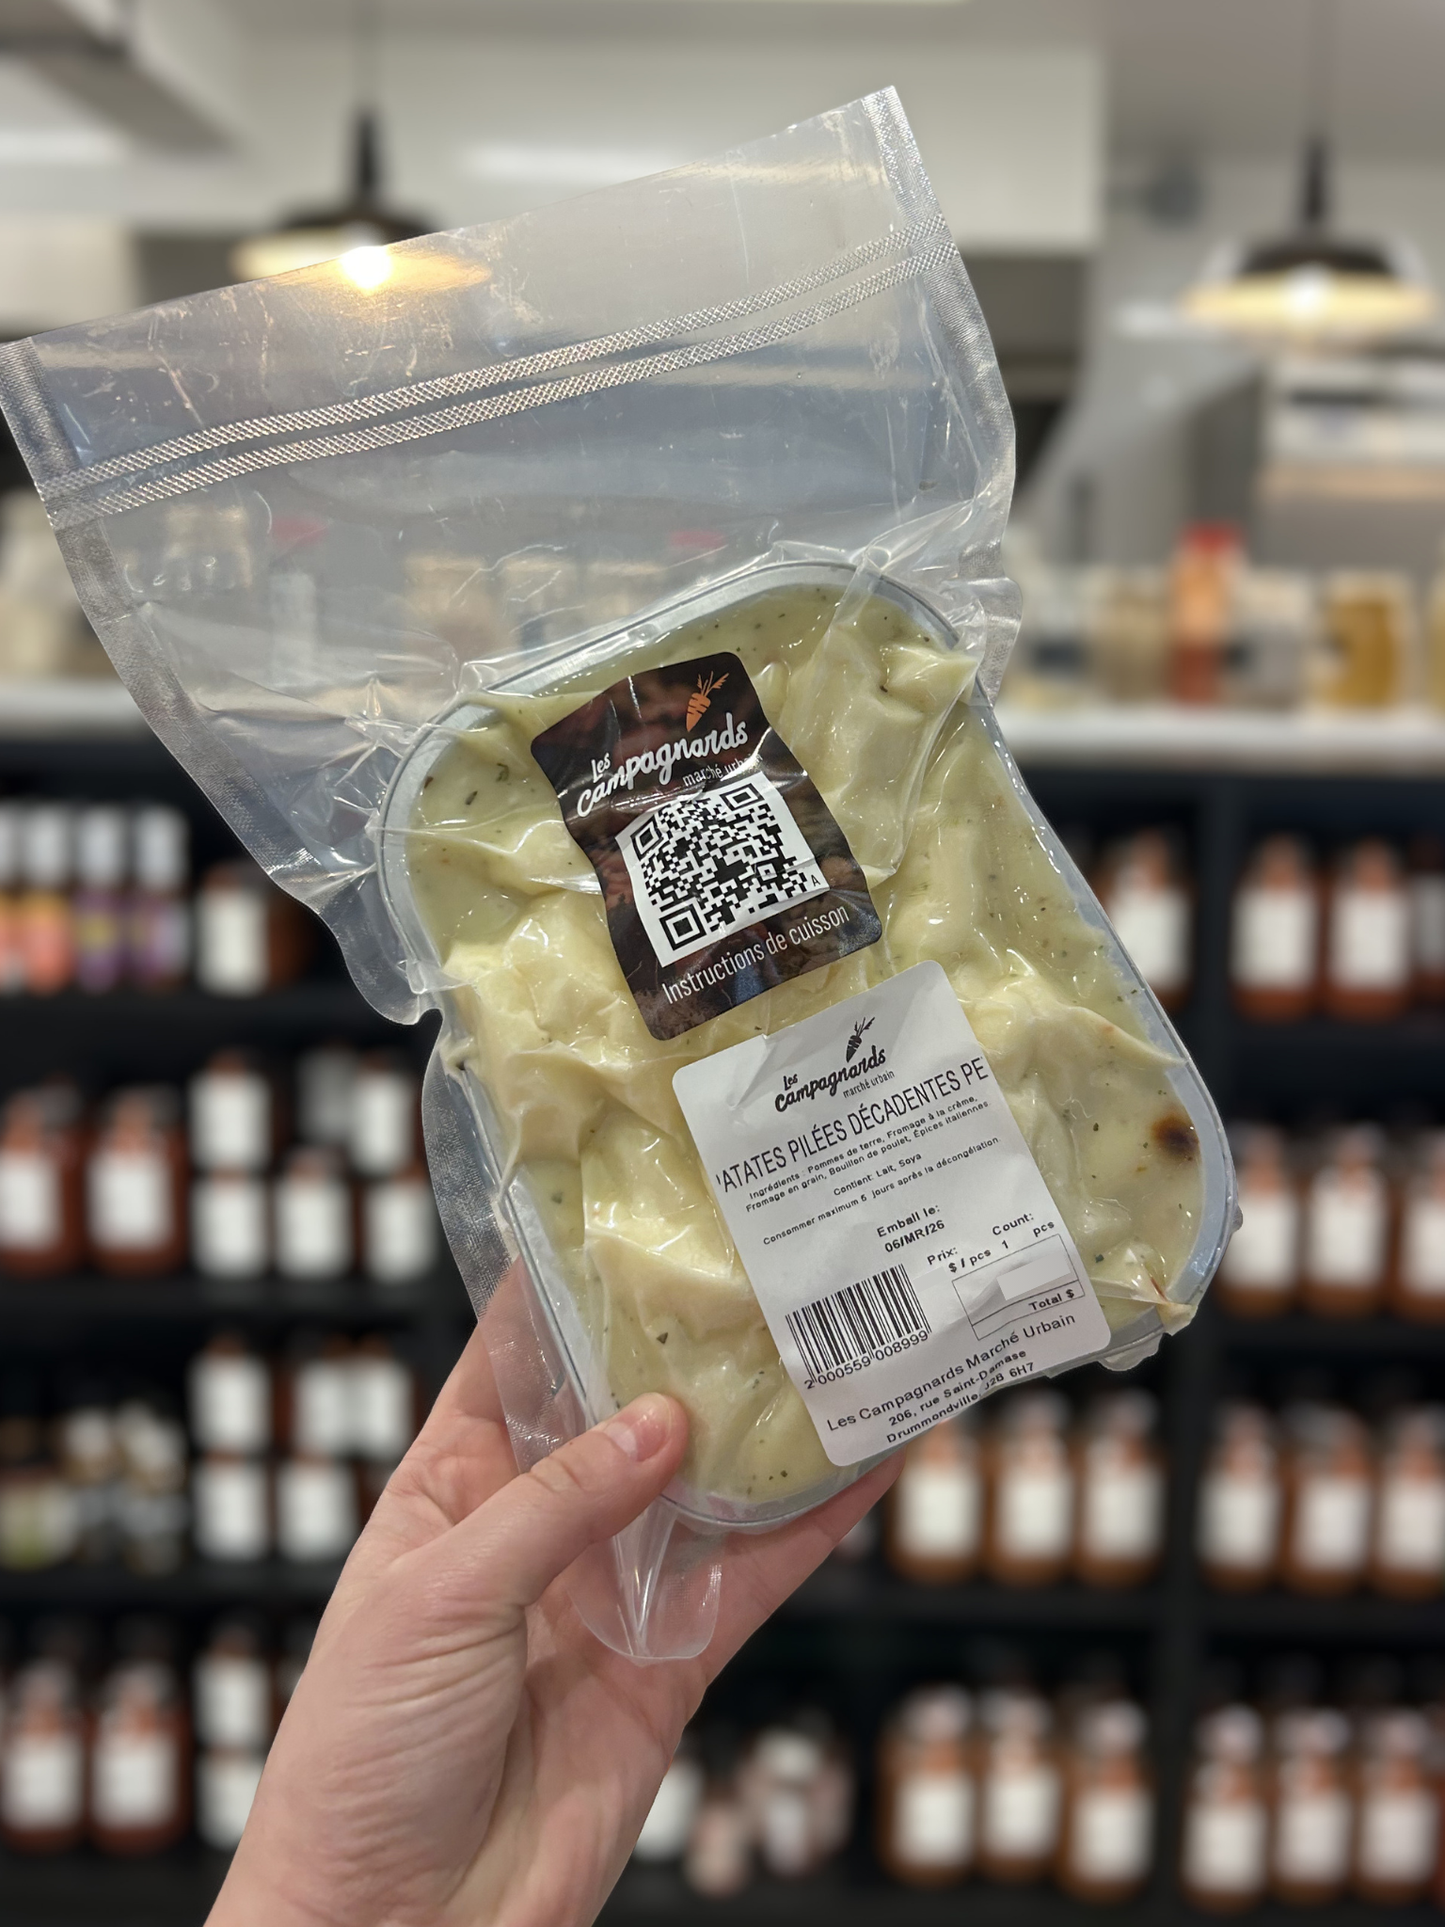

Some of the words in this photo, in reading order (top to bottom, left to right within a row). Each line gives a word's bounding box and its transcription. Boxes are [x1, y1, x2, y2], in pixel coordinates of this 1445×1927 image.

[591, 752, 611, 783] Les
[682, 763, 723, 786] marché
[811, 874, 821, 887] A
[662, 942, 765, 1004] Instructions
[766, 931, 788, 954] de
[788, 905, 850, 945] cuisson
[783, 1073, 798, 1091] Les
[843, 1079, 871, 1099] marché
[871, 1070, 895, 1086] urbain
[716, 1146, 787, 1193] ATATES
[787, 1119, 848, 1163] PILÉES
[847, 1069, 961, 1136] DÉCADENTES
[960, 1056, 989, 1086] PE
[745, 1190, 785, 1213] Fromage
[787, 1183, 800, 1195] en
[801, 1172, 827, 1189] grain,
[828, 1155, 865, 1176] Bouillon
[866, 1148, 879, 1160] de
[880, 1135, 912, 1154] poulet,
[913, 1121, 944, 1139] Épices
[749, 1173, 800, 1200] Ingrédients
[807, 1153, 845, 1174] Pommes
[846, 1147, 858, 1157] de
[859, 1136, 885, 1151] terre,
[886, 1117, 926, 1139] Fromage
[927, 1112, 935, 1121] à
[935, 1109, 946, 1118] la
[833, 1173, 874, 1196] Contient:
[876, 1163, 897, 1178] Lait,
[898, 1152, 922, 1168] Soya
[763, 1217, 815, 1245] Consommer
[817, 1198, 859, 1222] maximum
[871, 1182, 895, 1199] jours
[897, 1170, 923, 1187] après
[924, 1165, 934, 1175] la
[876, 1211, 921, 1238] Emball
[922, 1204, 940, 1218] le:
[884, 1219, 945, 1253] 06/MR/26
[991, 1211, 1034, 1236] Count:
[1001, 1239, 1009, 1250] 1
[1032, 1220, 1055, 1238] pcs
[926, 1246, 958, 1266] Prix:
[948, 1261, 958, 1274] $
[969, 1248, 992, 1267] pcs
[1028, 1292, 1063, 1311] Total
[1065, 1288, 1075, 1299] $
[827, 1415, 856, 1431] Les
[859, 1366, 964, 1421] Campagnards
[965, 1330, 1020, 1370] Marché
[1022, 1313, 1076, 1339] Urbain
[1008, 1361, 1034, 1378] 6H7
[888, 1410, 917, 1427] 206,
[919, 1395, 940, 1412] rue
[943, 1350, 1026, 1398] Saint-Damase
